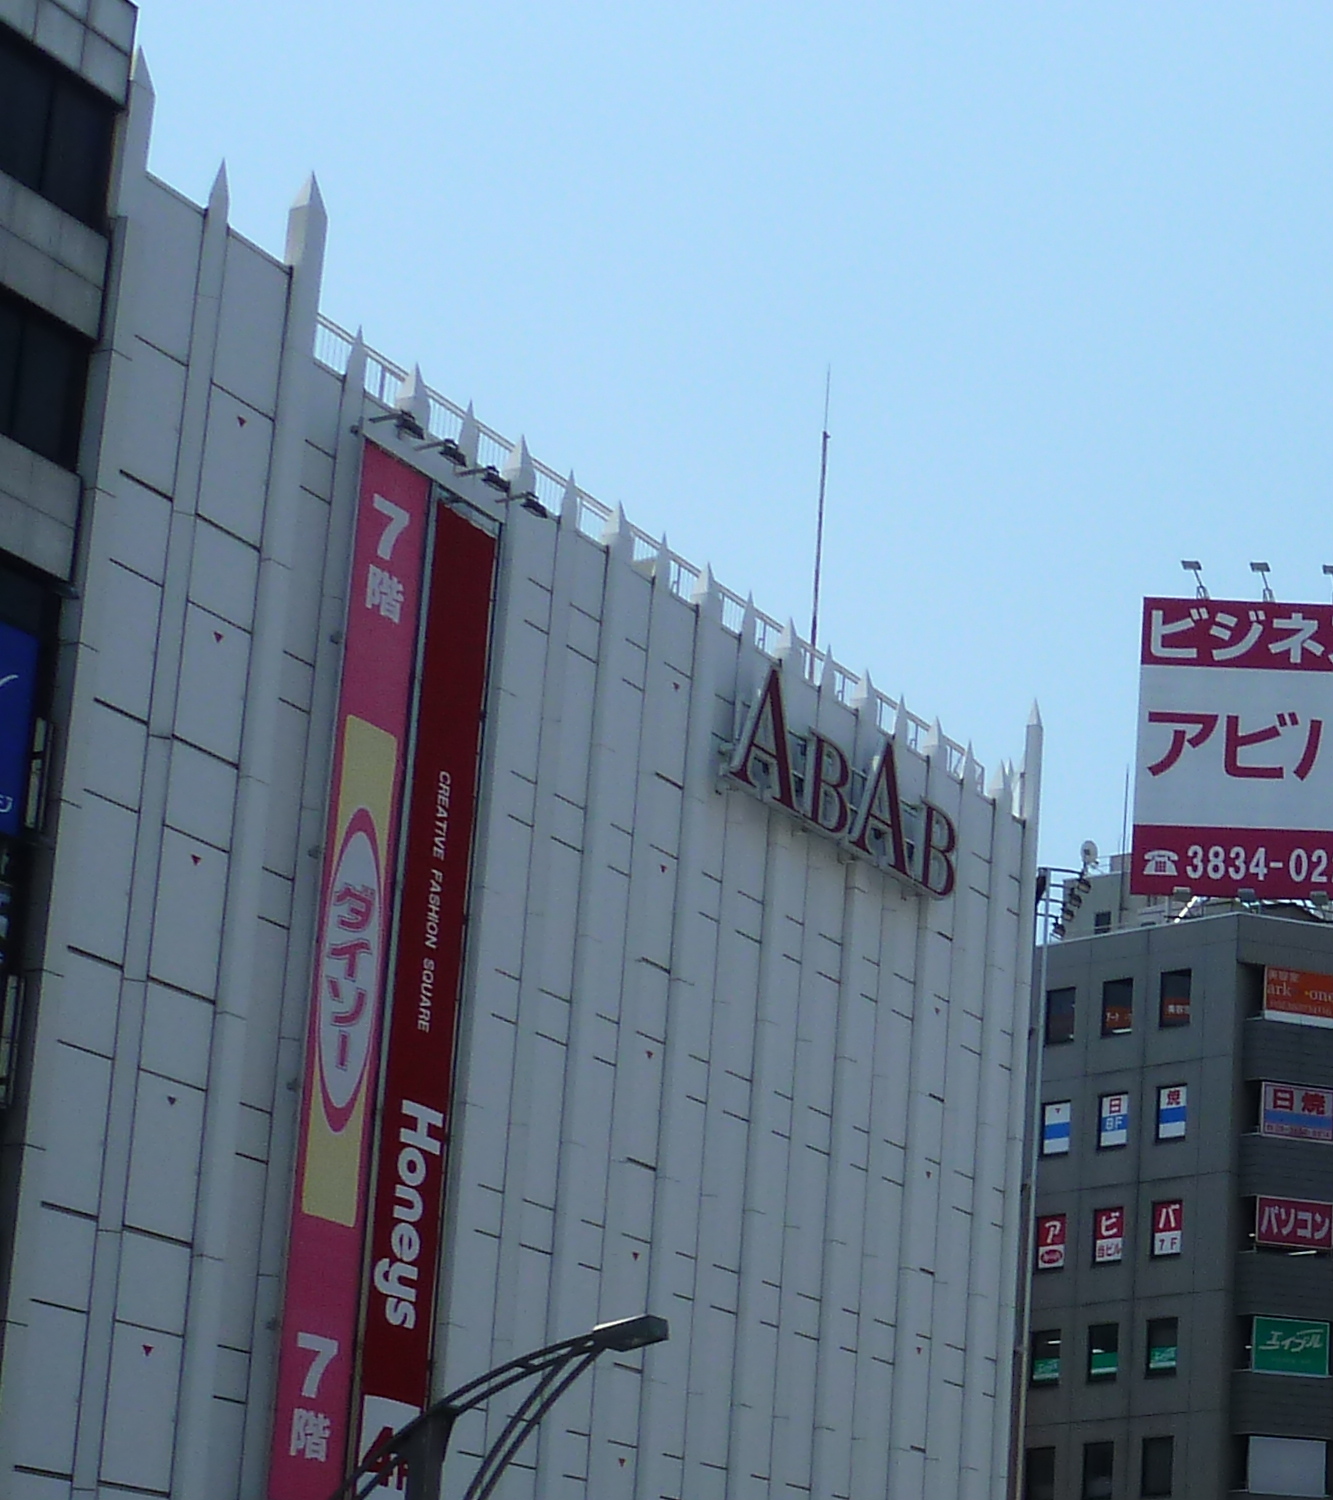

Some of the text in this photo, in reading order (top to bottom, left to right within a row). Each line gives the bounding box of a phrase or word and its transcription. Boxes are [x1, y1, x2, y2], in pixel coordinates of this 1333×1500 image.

[366, 493, 412, 625] 7階
[730, 666, 957, 901] ABAB
[415, 768, 452, 1034] CREATIVE FASHION SQUARE
[326, 886, 378, 1071] ダイソー
[1272, 1087, 1327, 1116] 日焼
[373, 1099, 445, 1331] Honeys
[1044, 1204, 1180, 1246] ア ビ バ
[1261, 1203, 1331, 1240] パソコン
[287, 1331, 339, 1463] 7階
[1257, 1327, 1326, 1353] エイブル
